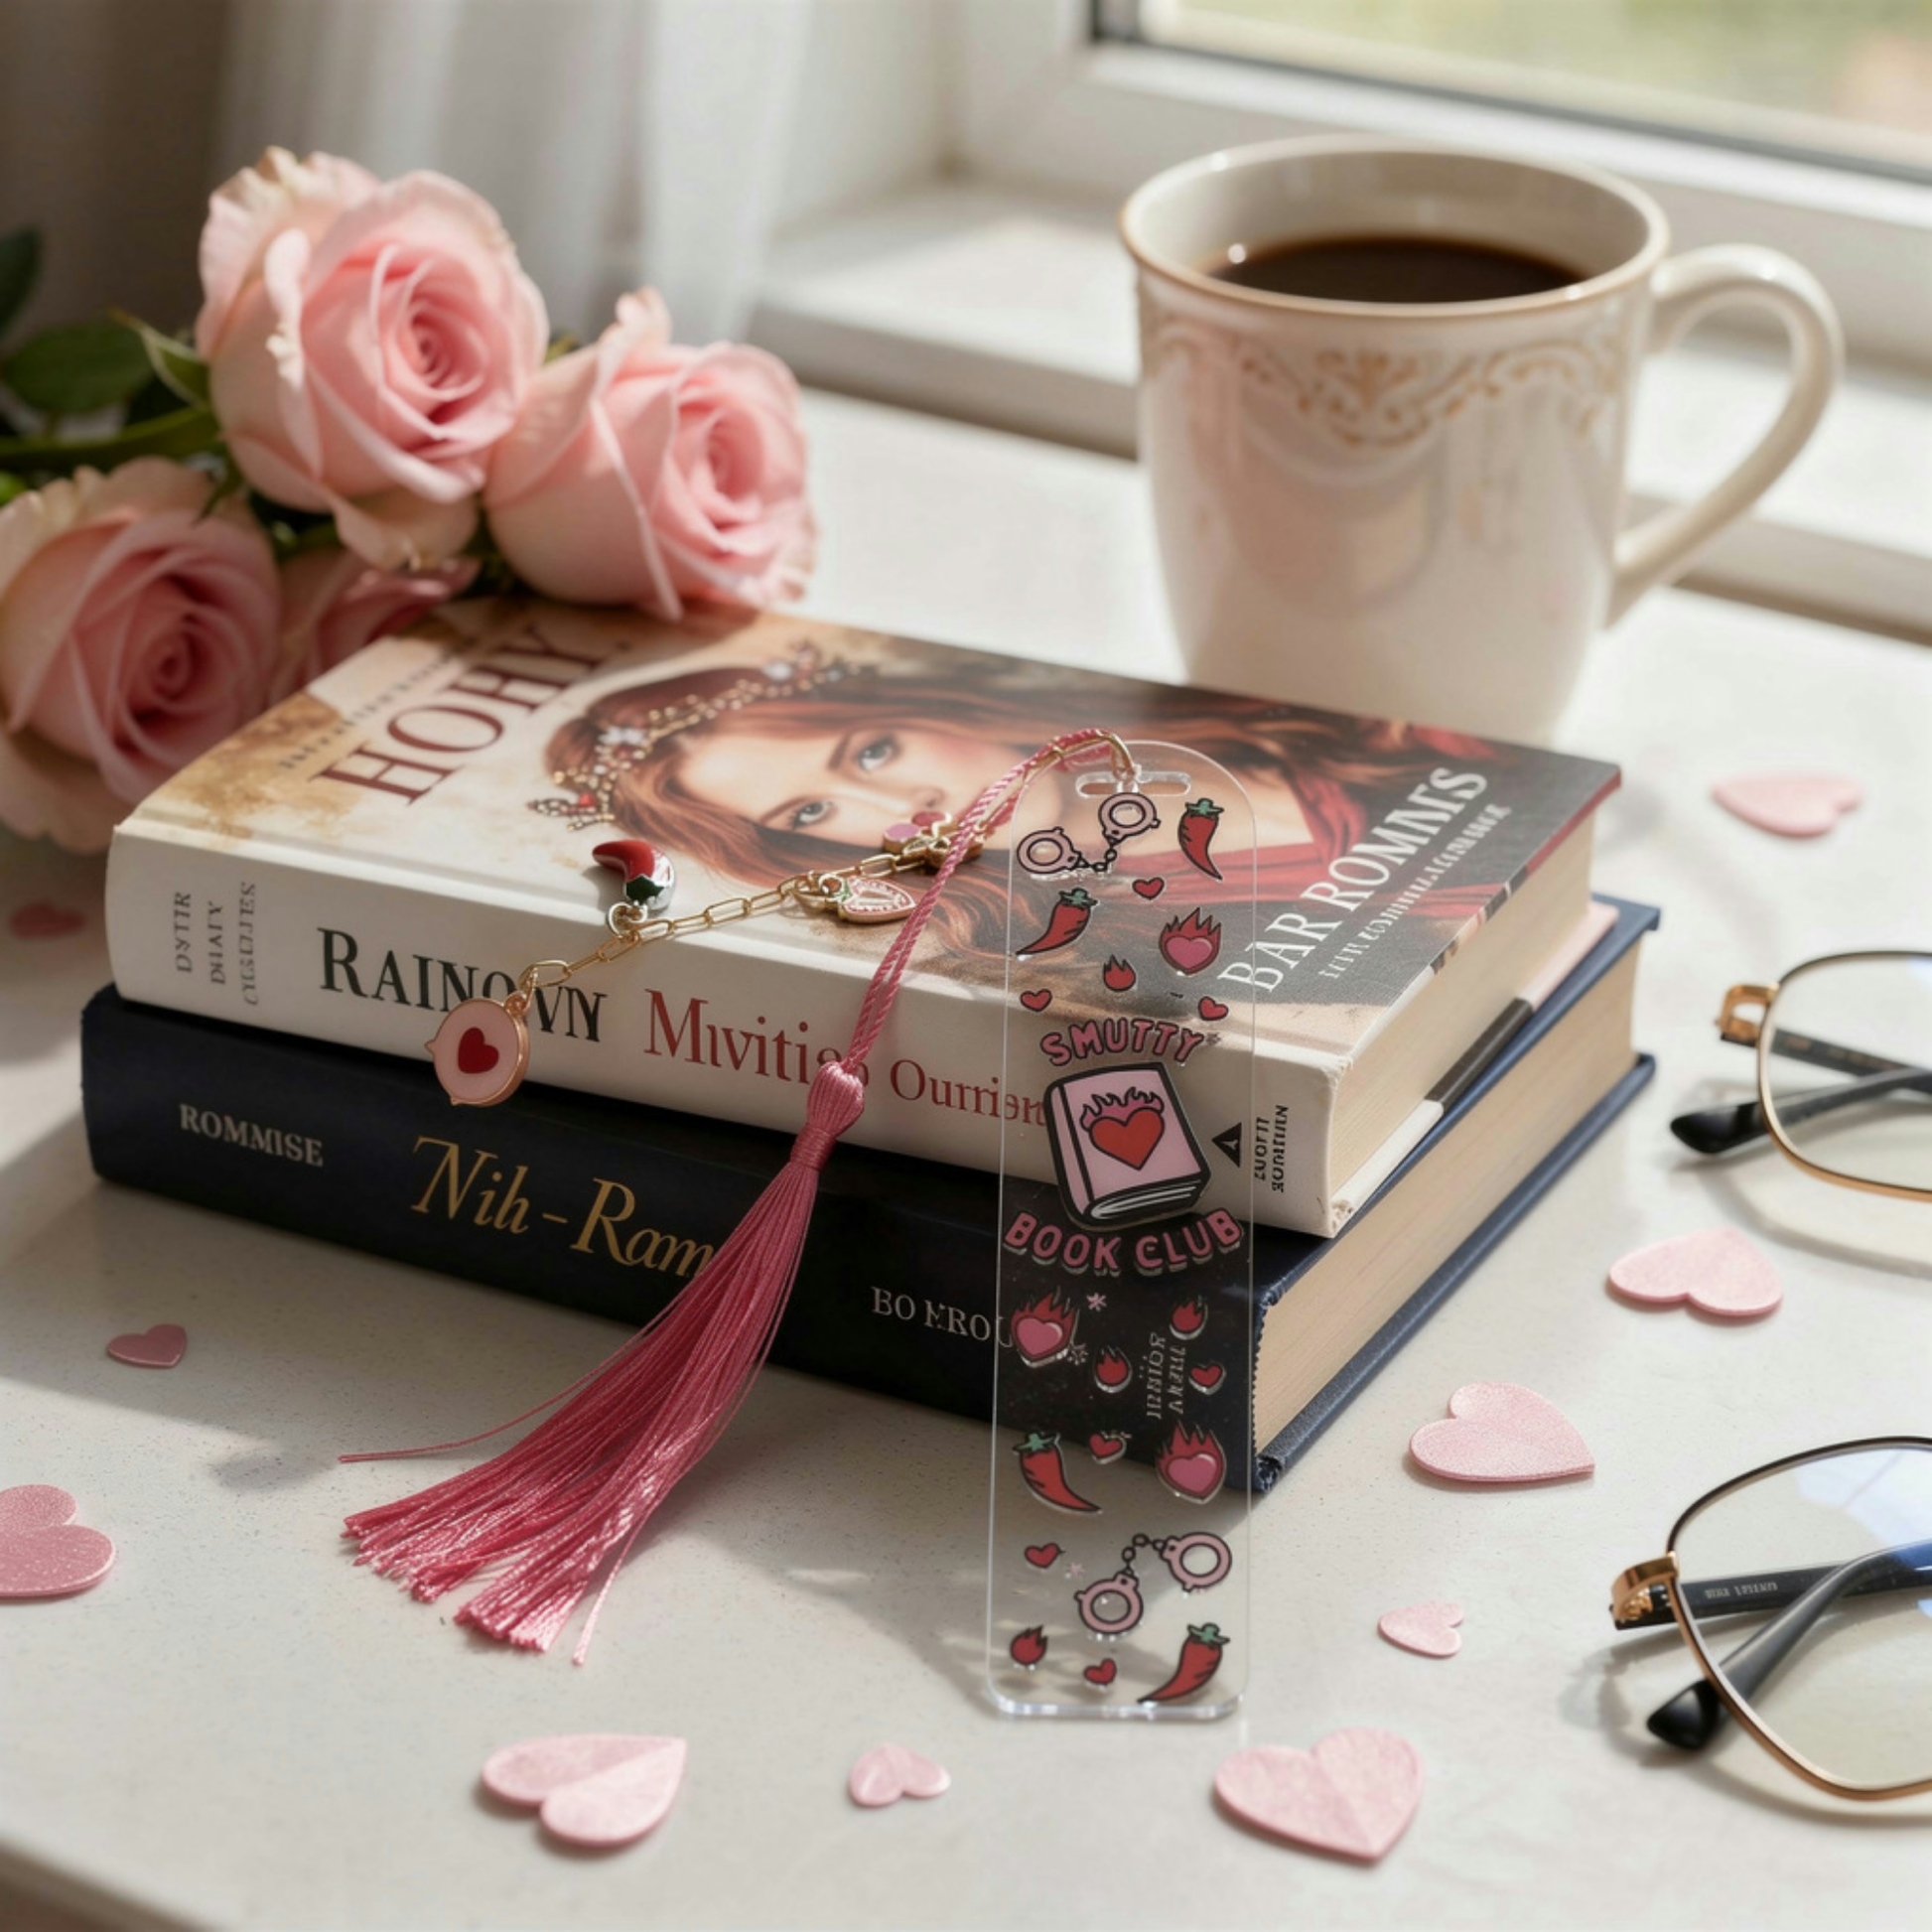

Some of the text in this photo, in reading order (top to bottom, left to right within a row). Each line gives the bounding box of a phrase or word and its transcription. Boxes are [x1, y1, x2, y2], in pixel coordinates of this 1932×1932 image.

[1217, 911, 1342, 993] BAR
[1039, 1017, 1205, 1067] SMUTTY
[1003, 1207, 1243, 1272] BOOK CLUB
